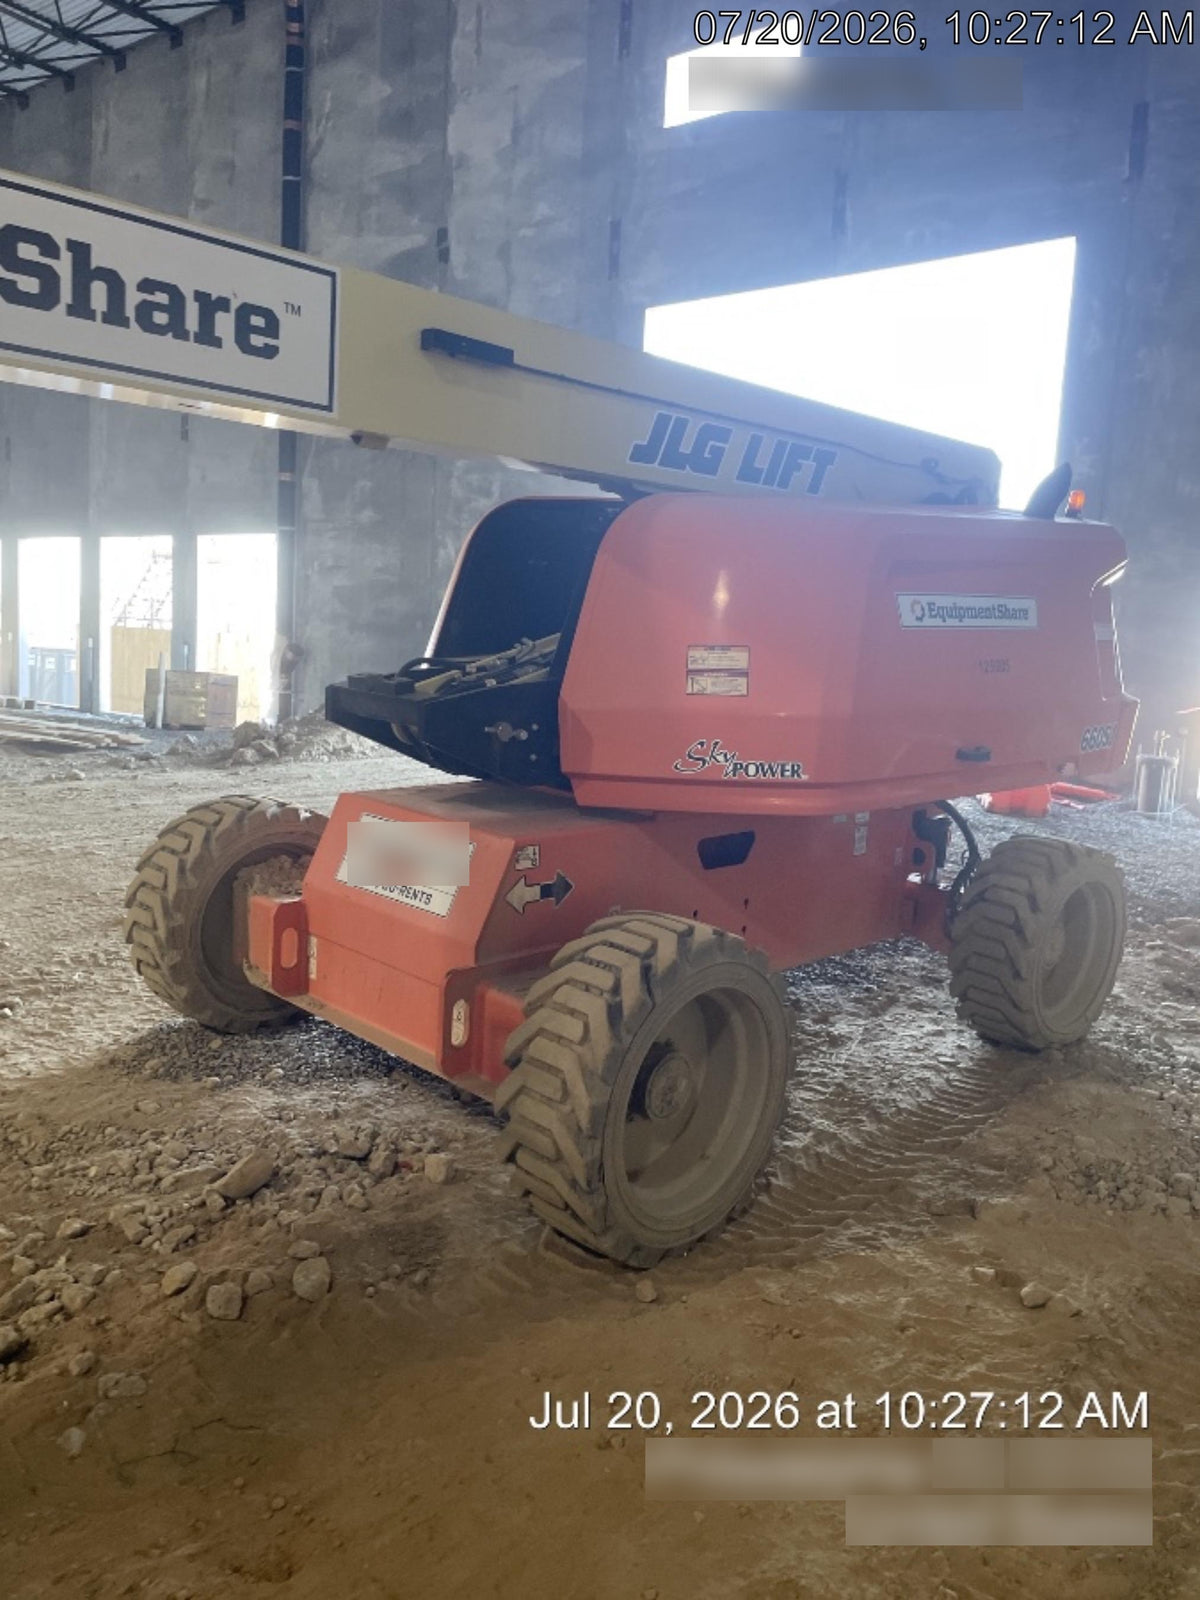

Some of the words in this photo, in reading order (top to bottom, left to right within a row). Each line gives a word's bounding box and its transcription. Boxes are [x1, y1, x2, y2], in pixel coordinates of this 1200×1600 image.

[0, 223, 280, 360] Share
[627, 411, 734, 479] JLG
[734, 431, 838, 496] LIFT
[926, 601, 1029, 623] EquipmentShare
[730, 760, 803, 779] POWER
